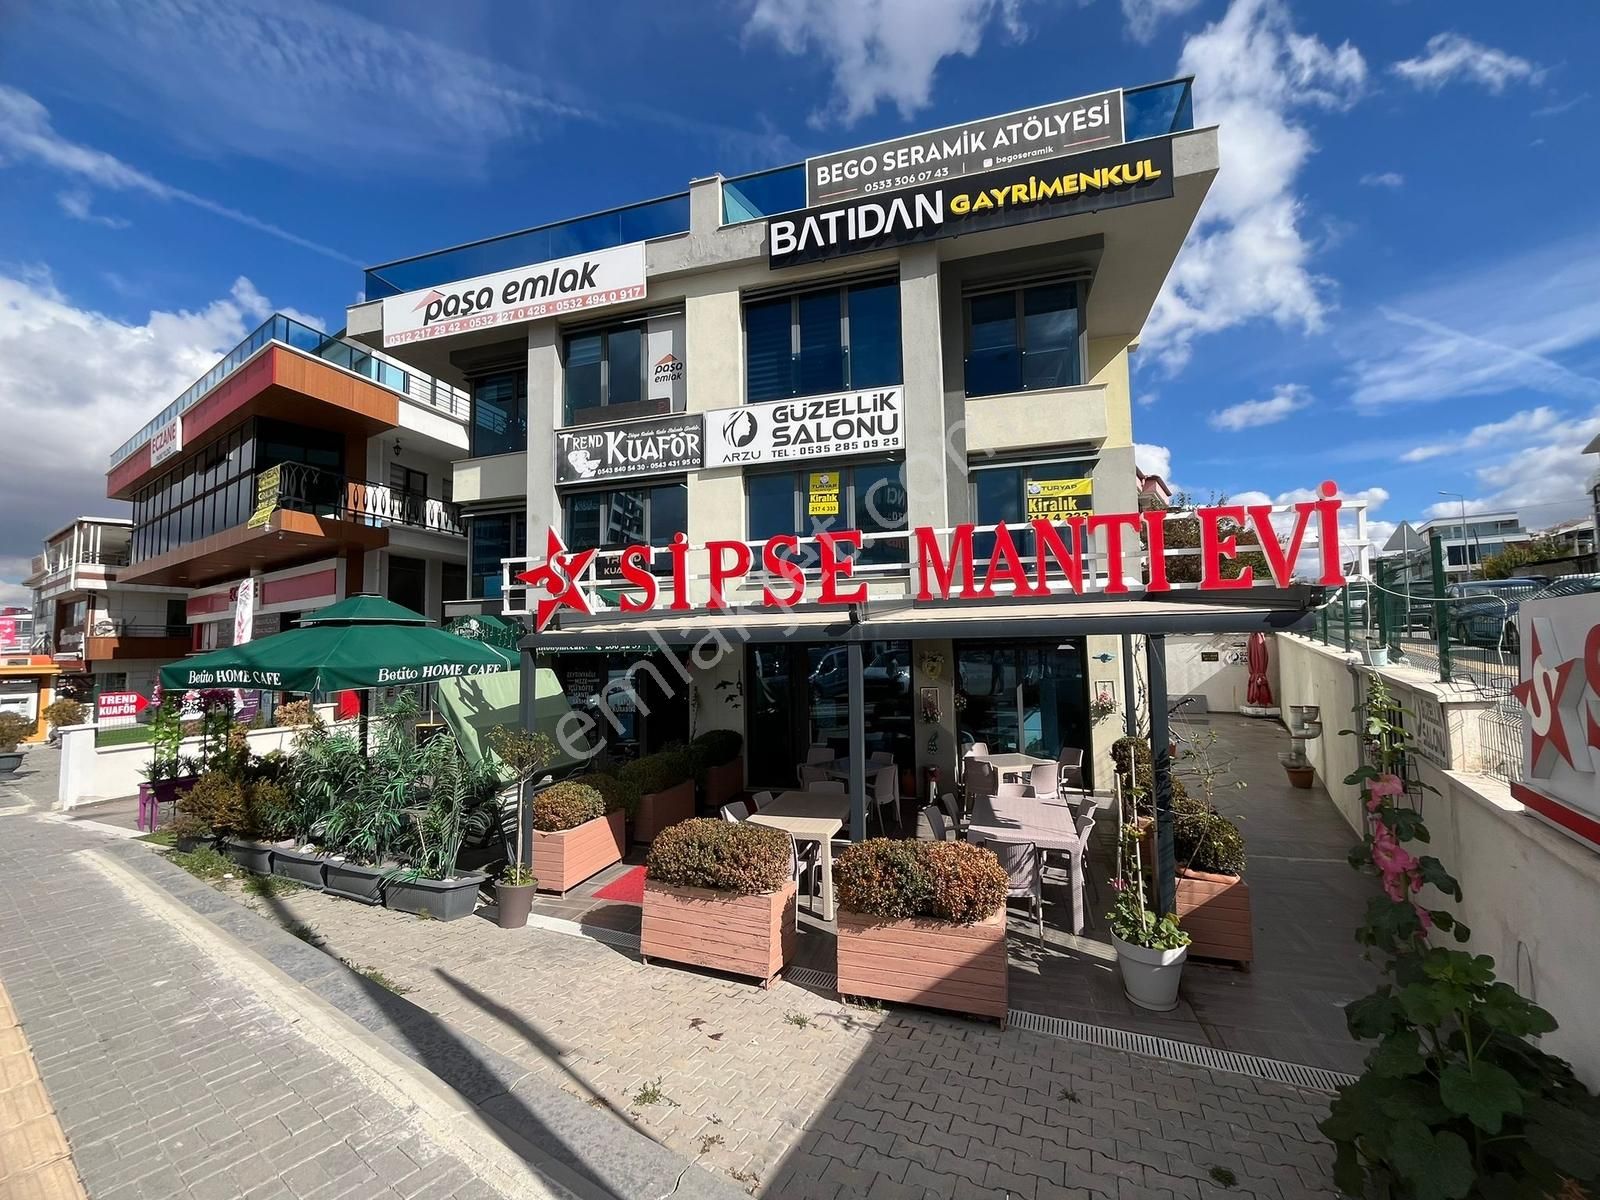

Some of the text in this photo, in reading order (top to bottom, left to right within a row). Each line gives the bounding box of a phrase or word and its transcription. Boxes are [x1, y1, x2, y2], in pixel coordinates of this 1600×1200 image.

[816, 99, 1110, 186] BEGO SERAMİK ATÖLYESİ
[996, 146, 1054, 165] begoseramik
[864, 167, 949, 192] 0533 306 07 43
[770, 159, 1162, 256] BATIDAN GAYRİMENKUL
[423, 261, 600, 326] paşa emlak
[389, 332, 412, 345] 0312
[414, 328, 432, 339] 217
[434, 325, 446, 335] 29
[448, 322, 461, 332] 42
[469, 316, 494, 328] 0532
[517, 308, 525, 318] 0
[527, 305, 546, 316] 428
[556, 298, 583, 311] 0532
[585, 294, 606, 305] 494
[609, 291, 617, 301] 0
[620, 287, 641, 299] 917
[654, 372, 682, 383] emlak
[772, 391, 897, 424] GÜZELLİK
[153, 422, 176, 454] ECZANE
[771, 413, 899, 447] SALONU
[558, 433, 604, 452] TREND
[603, 430, 701, 465] KUAFÖR
[772, 450, 789, 458] TEL
[800, 445, 831, 455] 0535
[835, 441, 858, 451] 285
[863, 439, 878, 448] 09
[883, 437, 899, 447] 29
[723, 450, 762, 463] ARZU
[597, 467, 613, 475] 0543
[1028, 497, 1078, 513] Kiralık
[1053, 513, 1061, 521] 4
[619, 479, 1346, 613] SİPSE MANTI EVİ
[188, 669, 281, 686] Betito HOME CAFE
[377, 665, 418, 683] Betito
[422, 664, 464, 678] HOME
[99, 705, 137, 715] KUAFÖR
[100, 695, 137, 705] TREND
